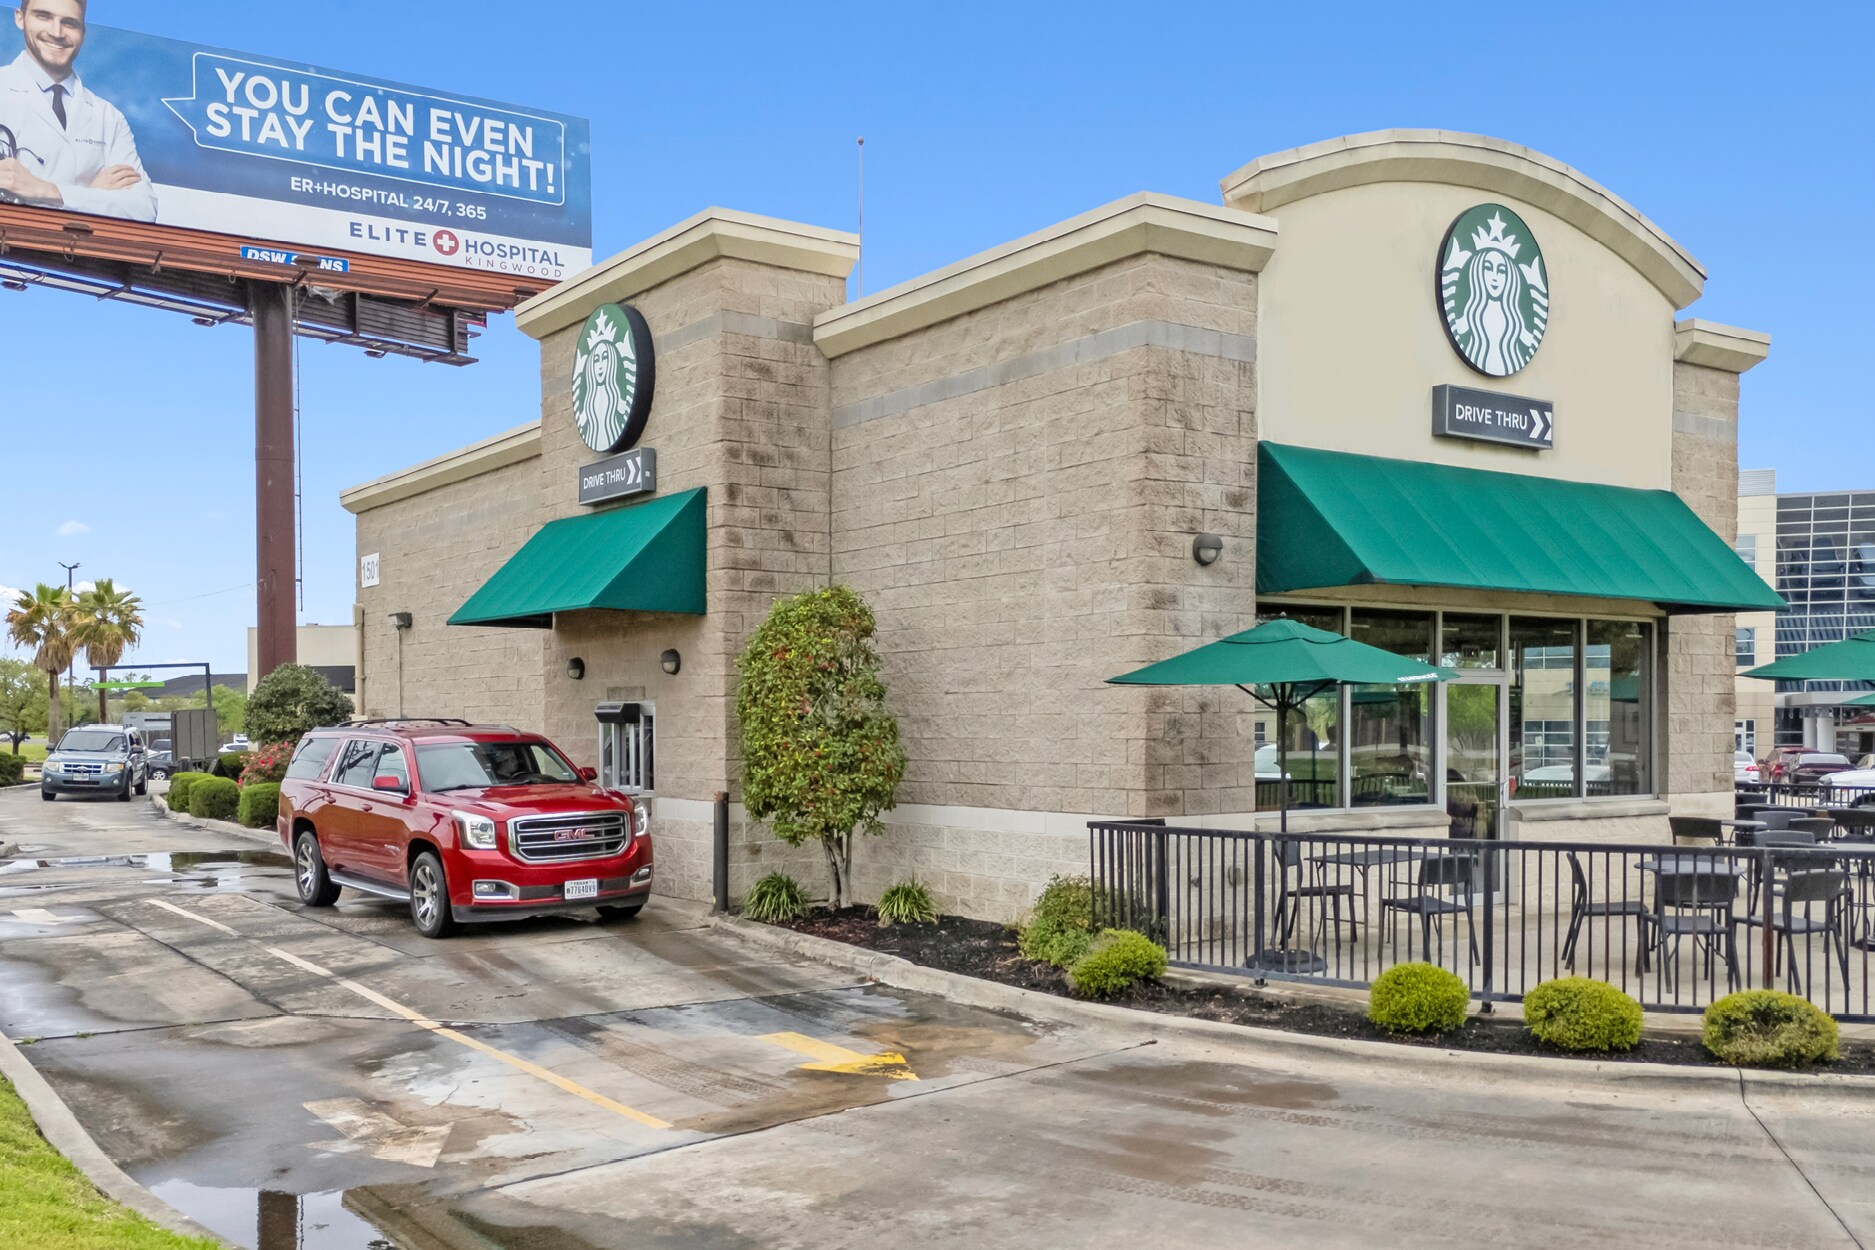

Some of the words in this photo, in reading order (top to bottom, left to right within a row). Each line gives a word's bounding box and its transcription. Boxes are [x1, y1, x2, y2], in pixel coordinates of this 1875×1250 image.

[215, 67, 309, 115] YOU
[325, 90, 414, 137] CAN
[430, 107, 533, 158] EVEN
[206, 102, 314, 150] STAY
[327, 123, 409, 169] THE
[424, 141, 555, 194] NIGHT!
[290, 176, 409, 208] ER+HOSPITAL
[413, 195, 452, 217] 24/7,
[455, 202, 487, 220] 365
[247, 248, 287, 264] DSW
[349, 221, 427, 247] ELITE
[465, 238, 565, 267] HOSPITAL
[465, 256, 562, 278] KINGWOOD
[1455, 403, 1492, 425] DRIVE
[1495, 410, 1528, 430] THRU
[583, 472, 604, 490] DRIVE
[605, 467, 626, 484] THRU
[362, 560, 379, 581] 1501
[554, 828, 595, 840] GMC
